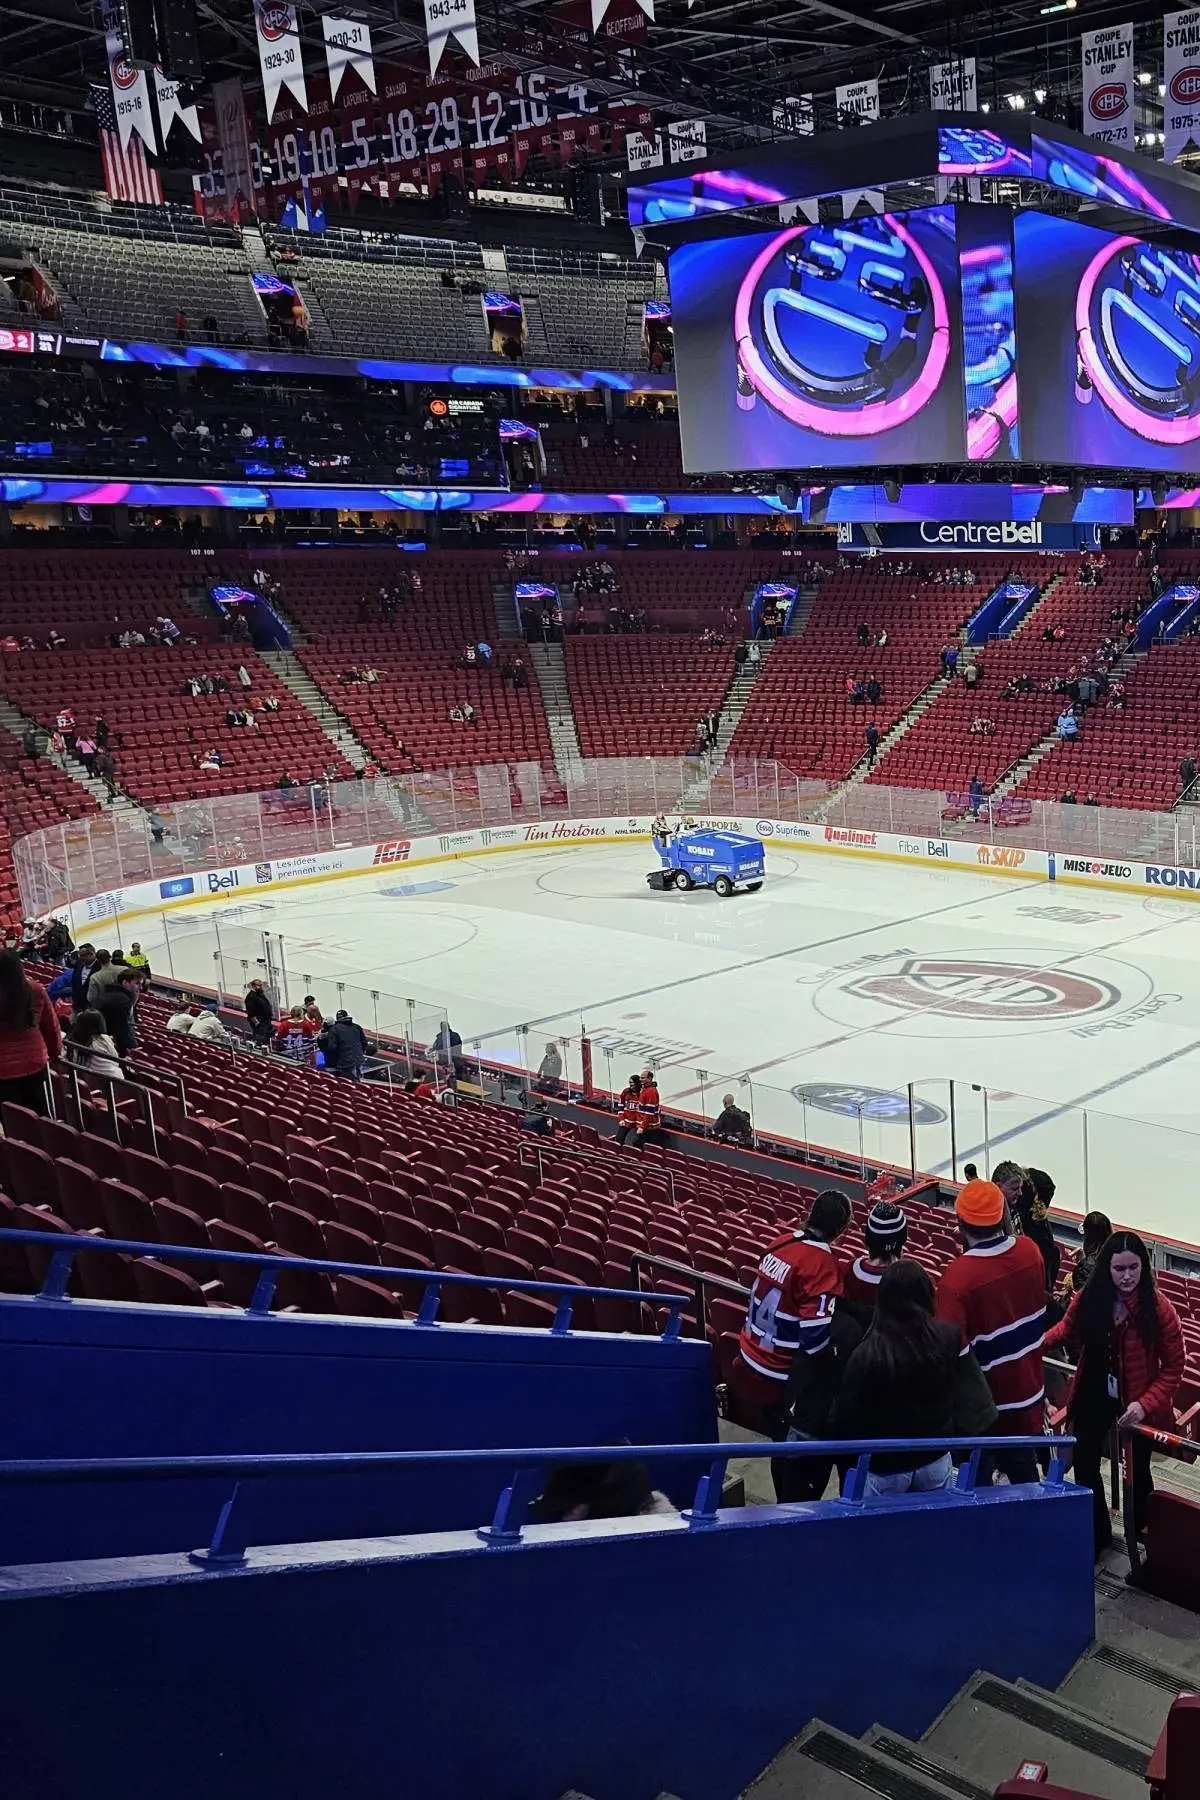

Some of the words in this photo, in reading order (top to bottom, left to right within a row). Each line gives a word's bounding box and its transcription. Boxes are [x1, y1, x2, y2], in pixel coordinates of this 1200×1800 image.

[429, 0, 467, 20] 1943-44
[606, 14, 645, 36] GEOFFRION
[1095, 30, 1121, 44] COUPE
[264, 49, 295, 70] 1929-30
[1084, 40, 1132, 66] STANLEY
[1183, 46, 1200, 58] CUP
[1101, 64, 1117, 75] CUP
[846, 85, 868, 97] COUPE
[931, 74, 975, 97] STANLEY
[117, 97, 142, 114] 1915-16
[425, 97, 461, 154] 29
[471, 91, 507, 149] 12
[677, 121, 696, 133] COUPE
[351, 117, 370, 168] 5
[387, 108, 418, 163] 18
[273, 133, 300, 186] 19
[308, 126, 337, 179] 10
[683, 150, 695, 160] CUP
[16, 334, 29, 348] 2
[521, 824, 549, 841] Tim
[550, 822, 606, 840] Hortons
[775, 823, 812, 838] Suprême
[825, 826, 878, 845] Qualinet
[373, 840, 413, 865] IGA
[687, 845, 715, 857] KOBALT
[898, 840, 920, 854] Fibe
[927, 840, 949, 858] Bell
[992, 846, 1026, 868] SKIP
[276, 860, 293, 870] Les
[293, 855, 317, 867] idées
[277, 866, 316, 880] prennent
[317, 863, 331, 873] vie
[332, 861, 343, 871] ici
[207, 869, 239, 890] Bell
[758, 1252, 791, 1285] SUZUKI
[745, 1279, 783, 1350] 14
[816, 1294, 836, 1317] 14
